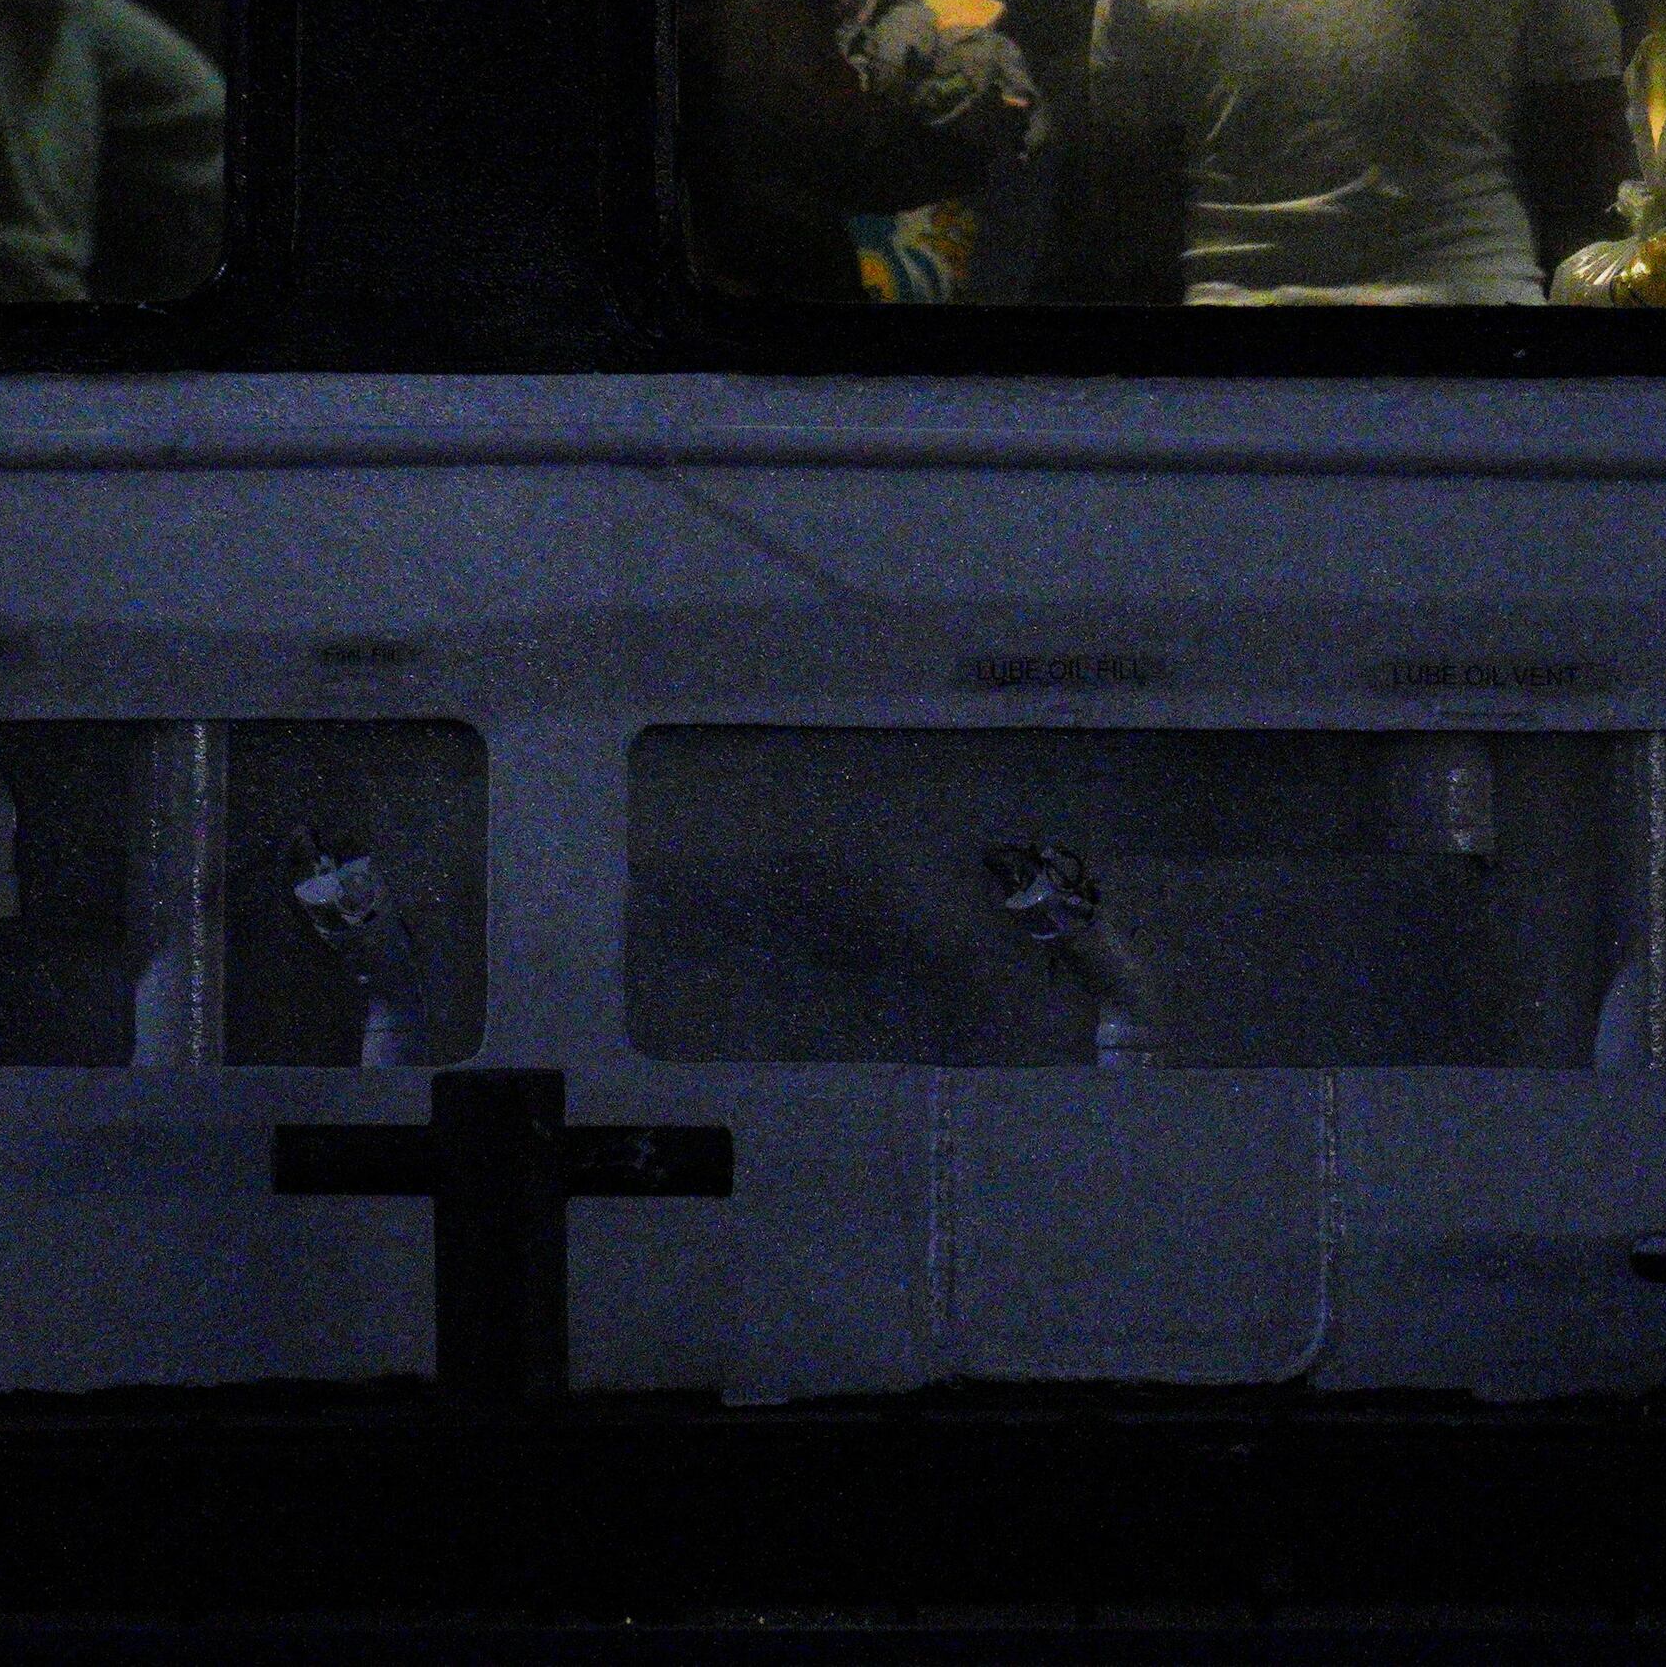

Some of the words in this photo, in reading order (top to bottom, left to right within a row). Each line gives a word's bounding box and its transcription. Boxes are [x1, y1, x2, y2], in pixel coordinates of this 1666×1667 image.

[976, 659, 1043, 681] LUBE
[1047, 659, 1086, 682] OIL
[1392, 664, 1458, 687] LUBE
[1464, 664, 1507, 687] OIL
[1511, 665, 1581, 687] VENT
